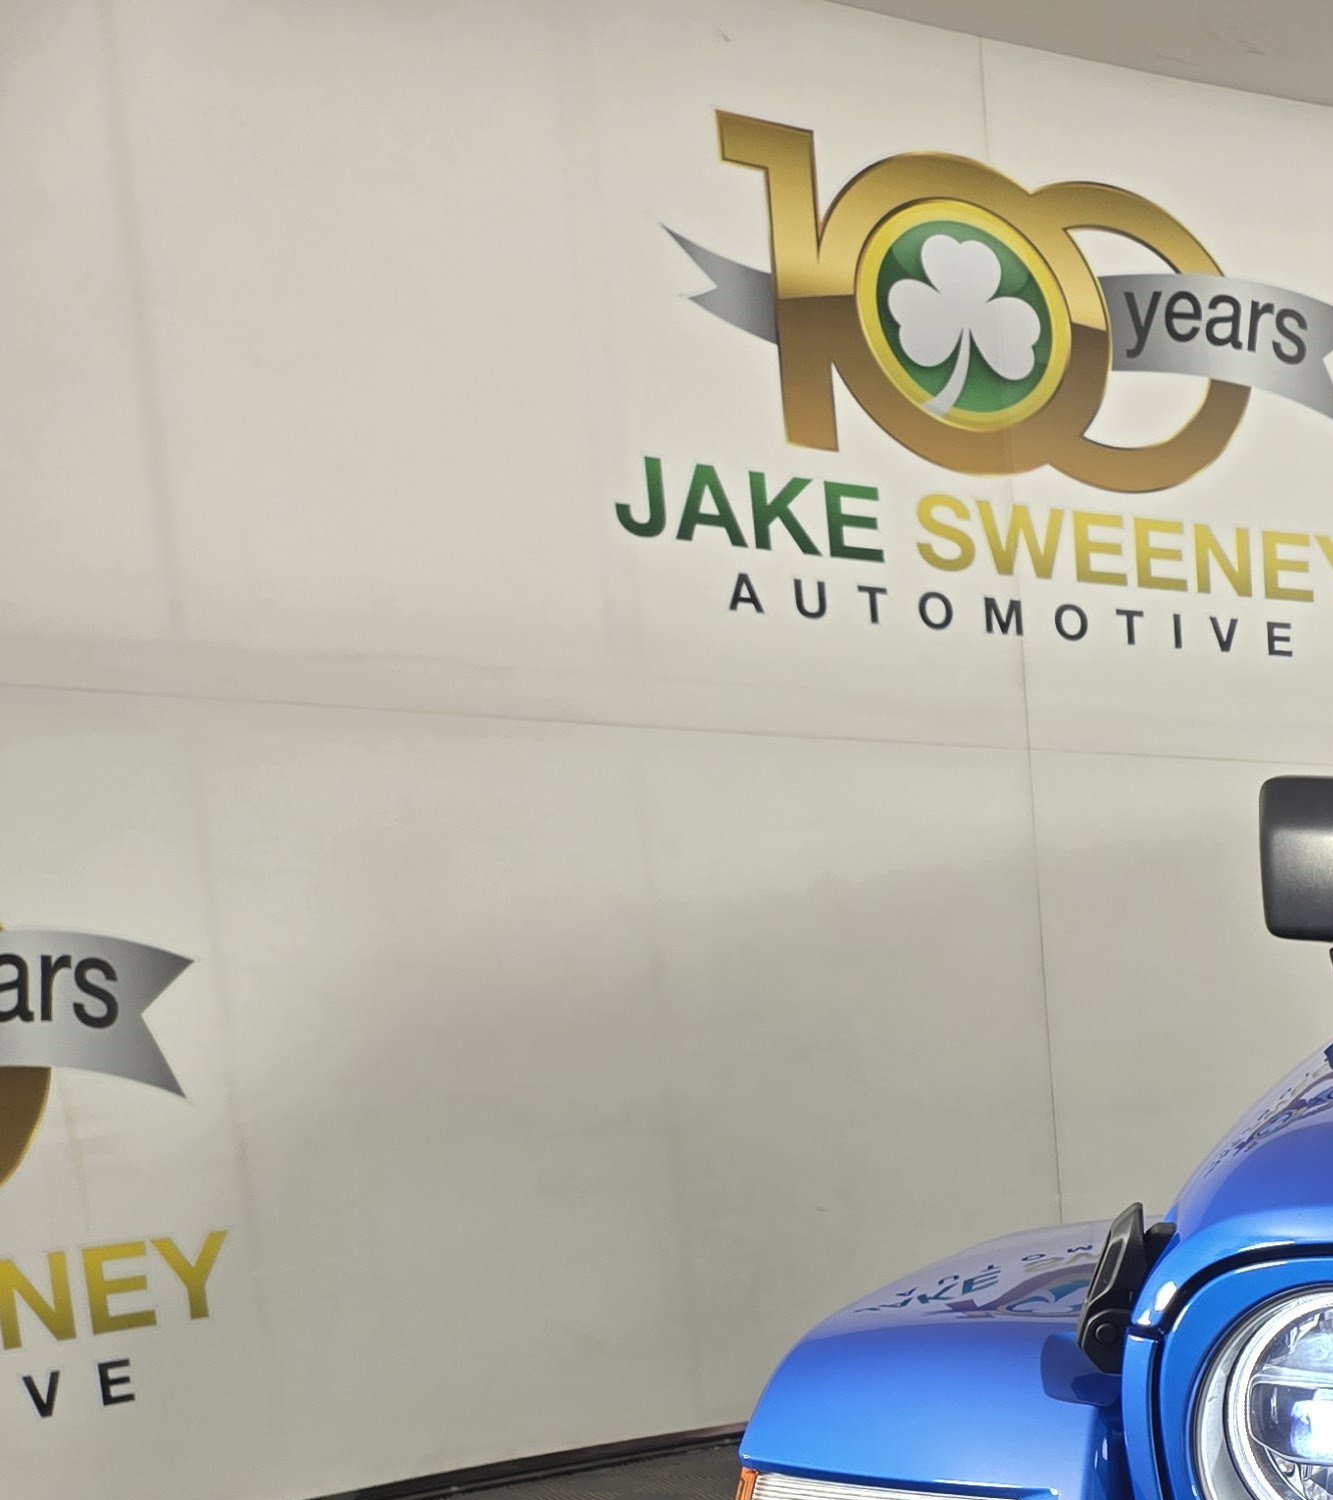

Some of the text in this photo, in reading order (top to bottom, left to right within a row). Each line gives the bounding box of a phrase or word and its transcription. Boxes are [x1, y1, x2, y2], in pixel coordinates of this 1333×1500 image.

[715, 108, 1309, 494] 100 years
[615, 456, 885, 563] JAKE
[728, 572, 1294, 658] AUTOMOTIVE
